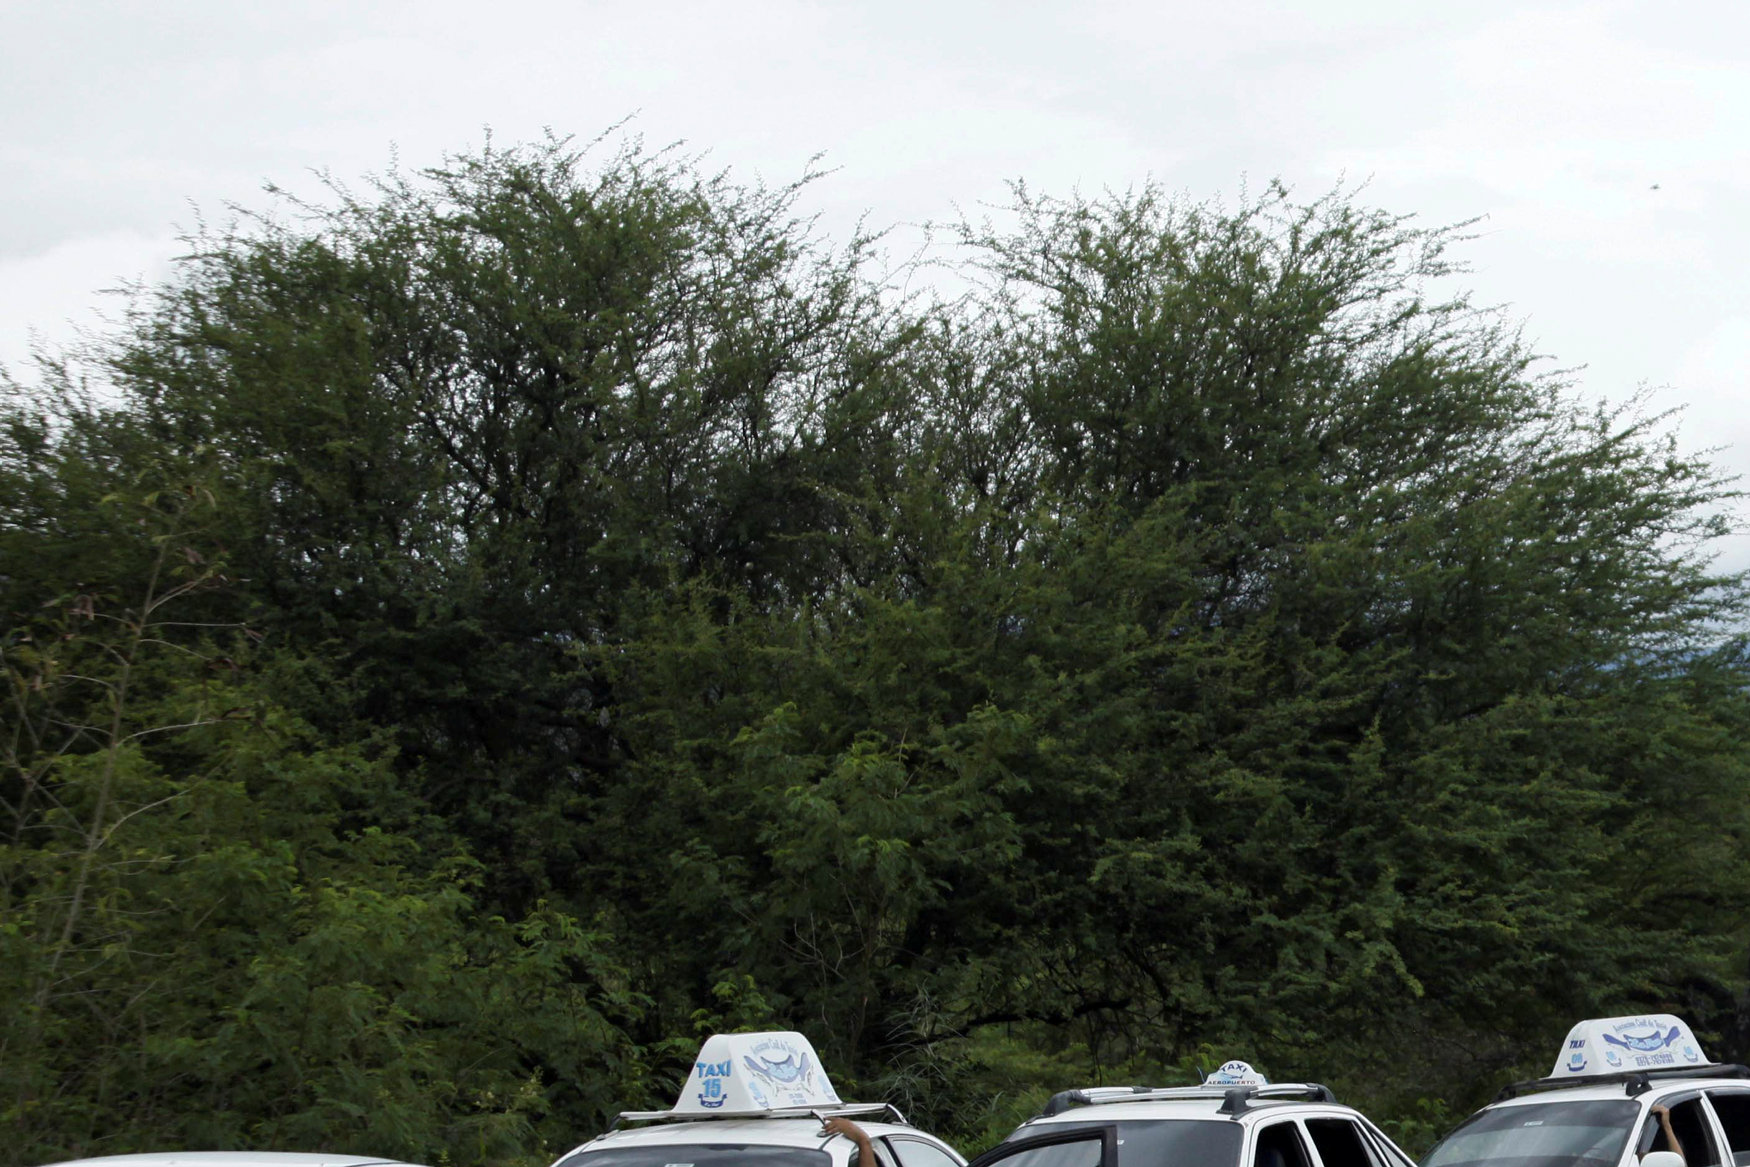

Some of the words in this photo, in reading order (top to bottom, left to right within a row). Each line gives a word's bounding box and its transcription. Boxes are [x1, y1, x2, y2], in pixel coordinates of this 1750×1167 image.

[696, 1060, 731, 1077] TAXI
[1221, 1063, 1247, 1073] TAXI
[702, 1078, 721, 1098] 15
